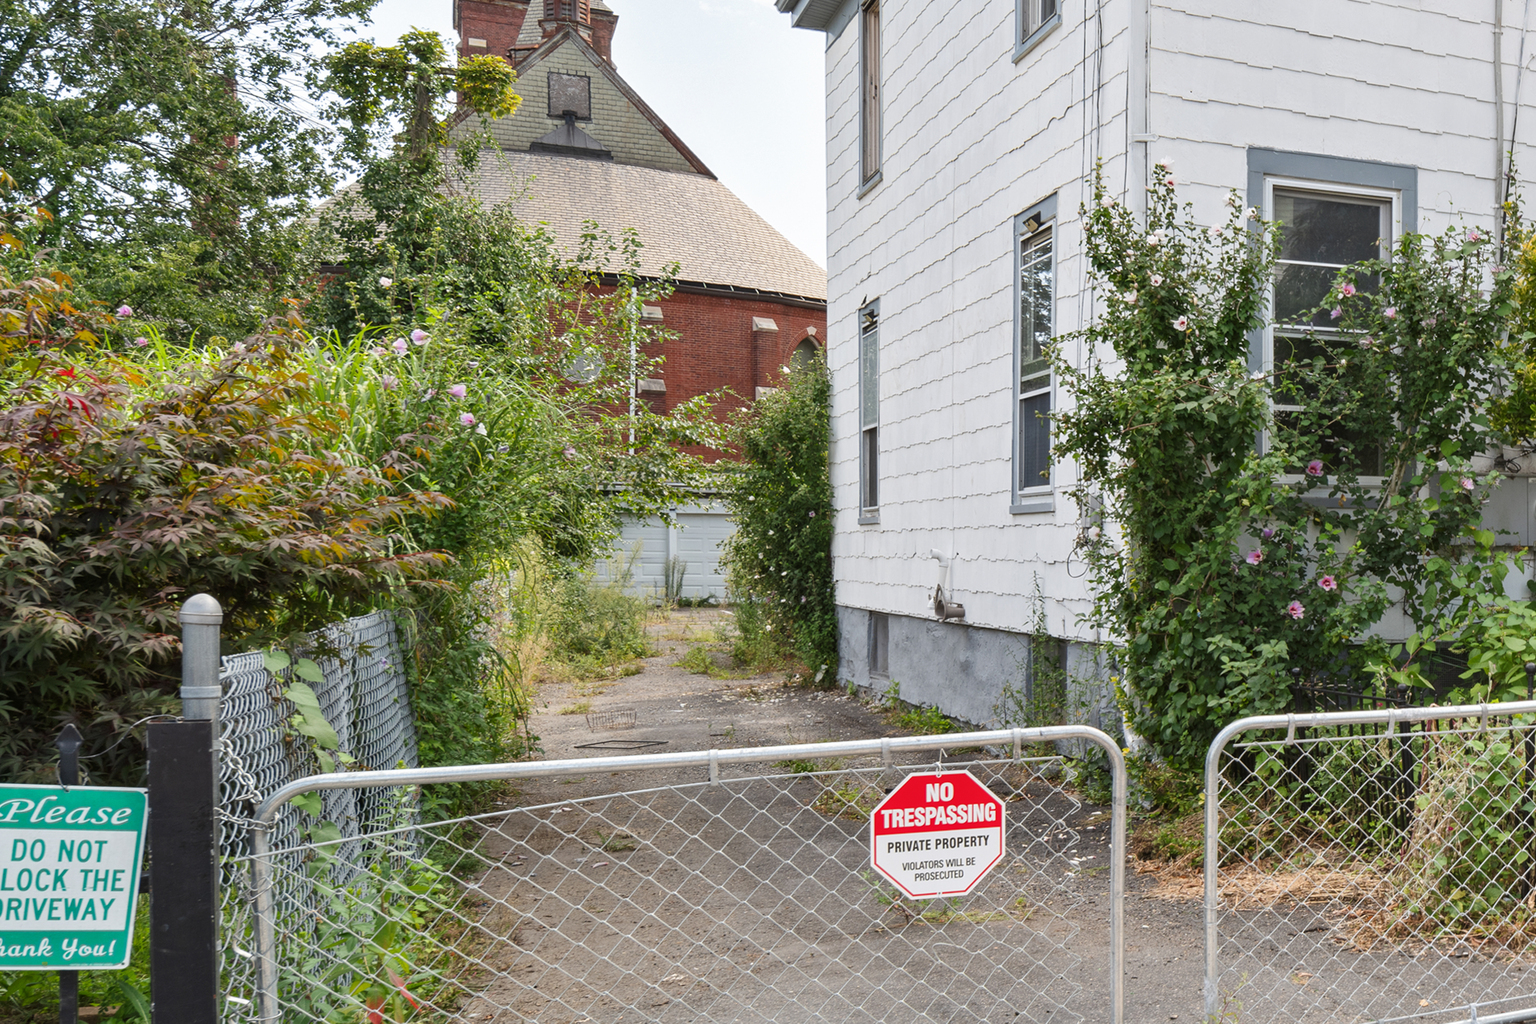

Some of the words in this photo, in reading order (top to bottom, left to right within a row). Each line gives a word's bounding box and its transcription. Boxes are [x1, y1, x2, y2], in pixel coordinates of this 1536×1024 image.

[926, 782, 954, 802] NO
[0, 796, 132, 825] Please
[881, 803, 996, 828] TRESPASSING
[11, 839, 46, 862] DO
[58, 840, 108, 862] NOT
[887, 839, 931, 853] PRIVATE
[935, 835, 989, 850] PROPERTY
[902, 859, 944, 871] VIOLATORS
[946, 858, 964, 868] WILL
[966, 857, 976, 866] BE
[80, 869, 125, 892] THE
[914, 870, 964, 881] PROSECUTED
[0, 898, 115, 921] RIVEWAY
[61, 938, 117, 960] You!
